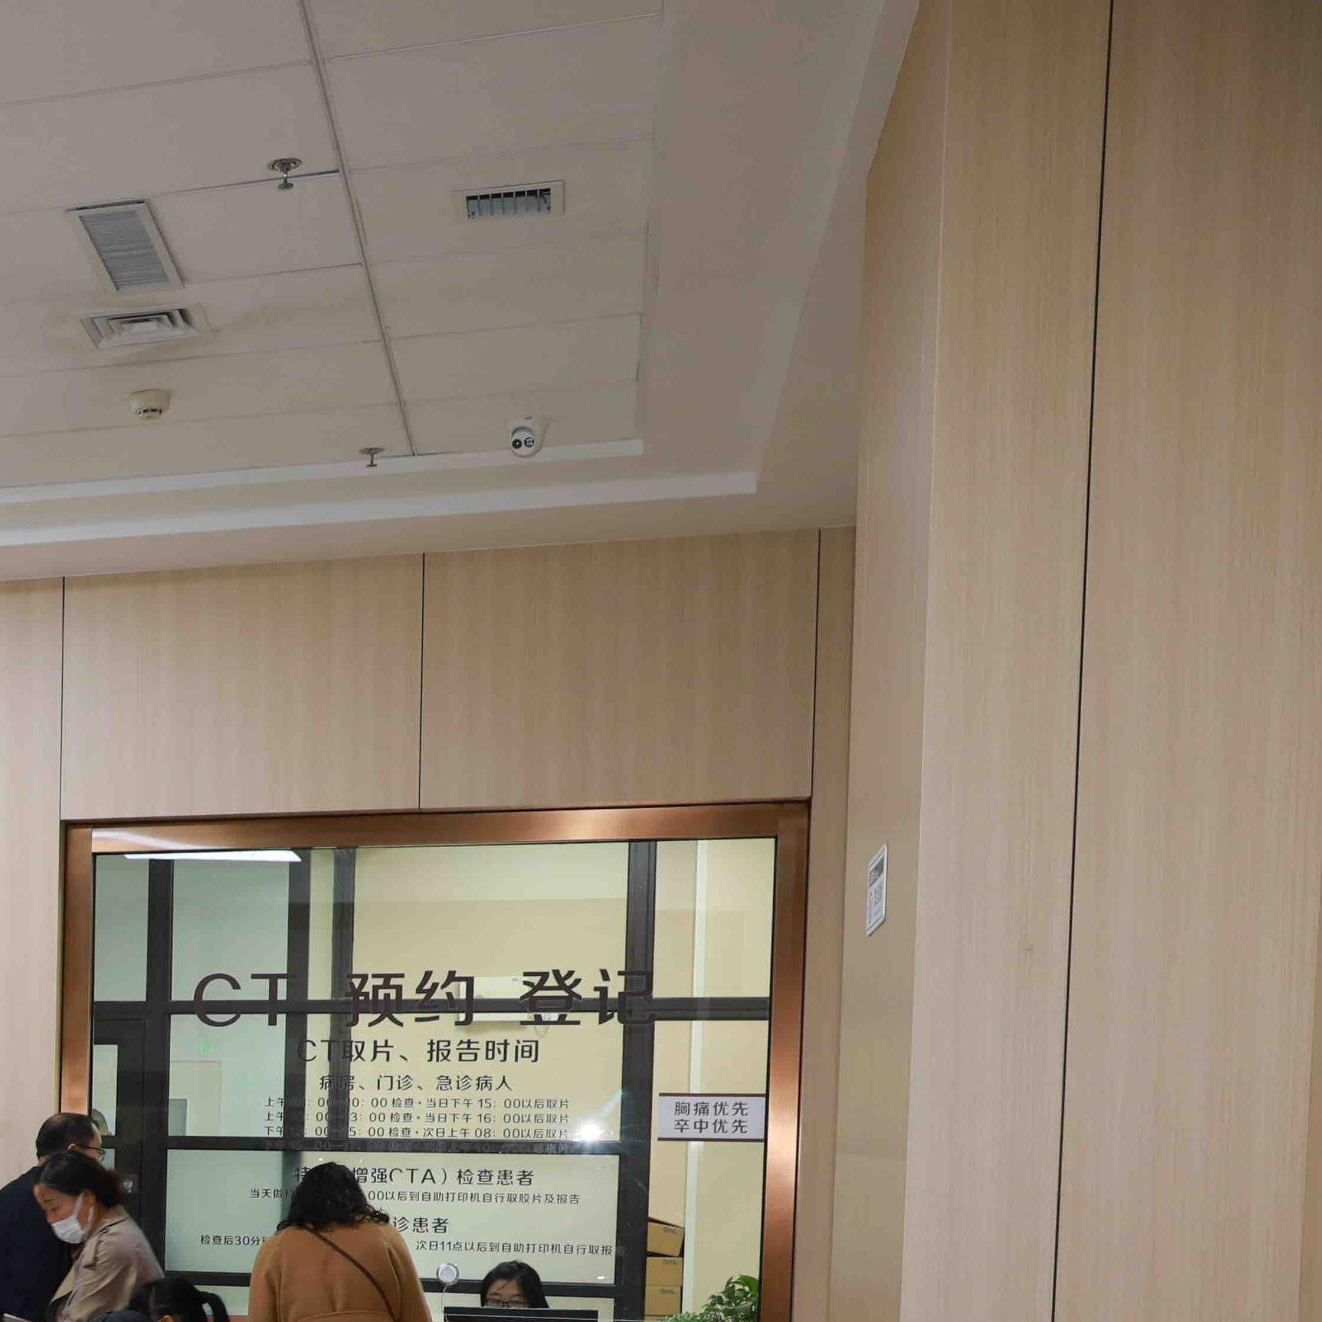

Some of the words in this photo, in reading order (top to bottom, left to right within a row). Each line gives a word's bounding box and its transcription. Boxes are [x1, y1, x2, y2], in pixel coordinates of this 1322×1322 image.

[193, 972, 296, 1027] CT
[346, 969, 475, 1028] 预约
[520, 967, 655, 1027] 登记
[296, 1039, 541, 1064] CT取片、报告时间
[319, 1074, 514, 1092] 病房、门诊、急诊病人
[674, 1101, 749, 1117] 胸痛优先
[673, 1118, 749, 1135] 卒中优先
